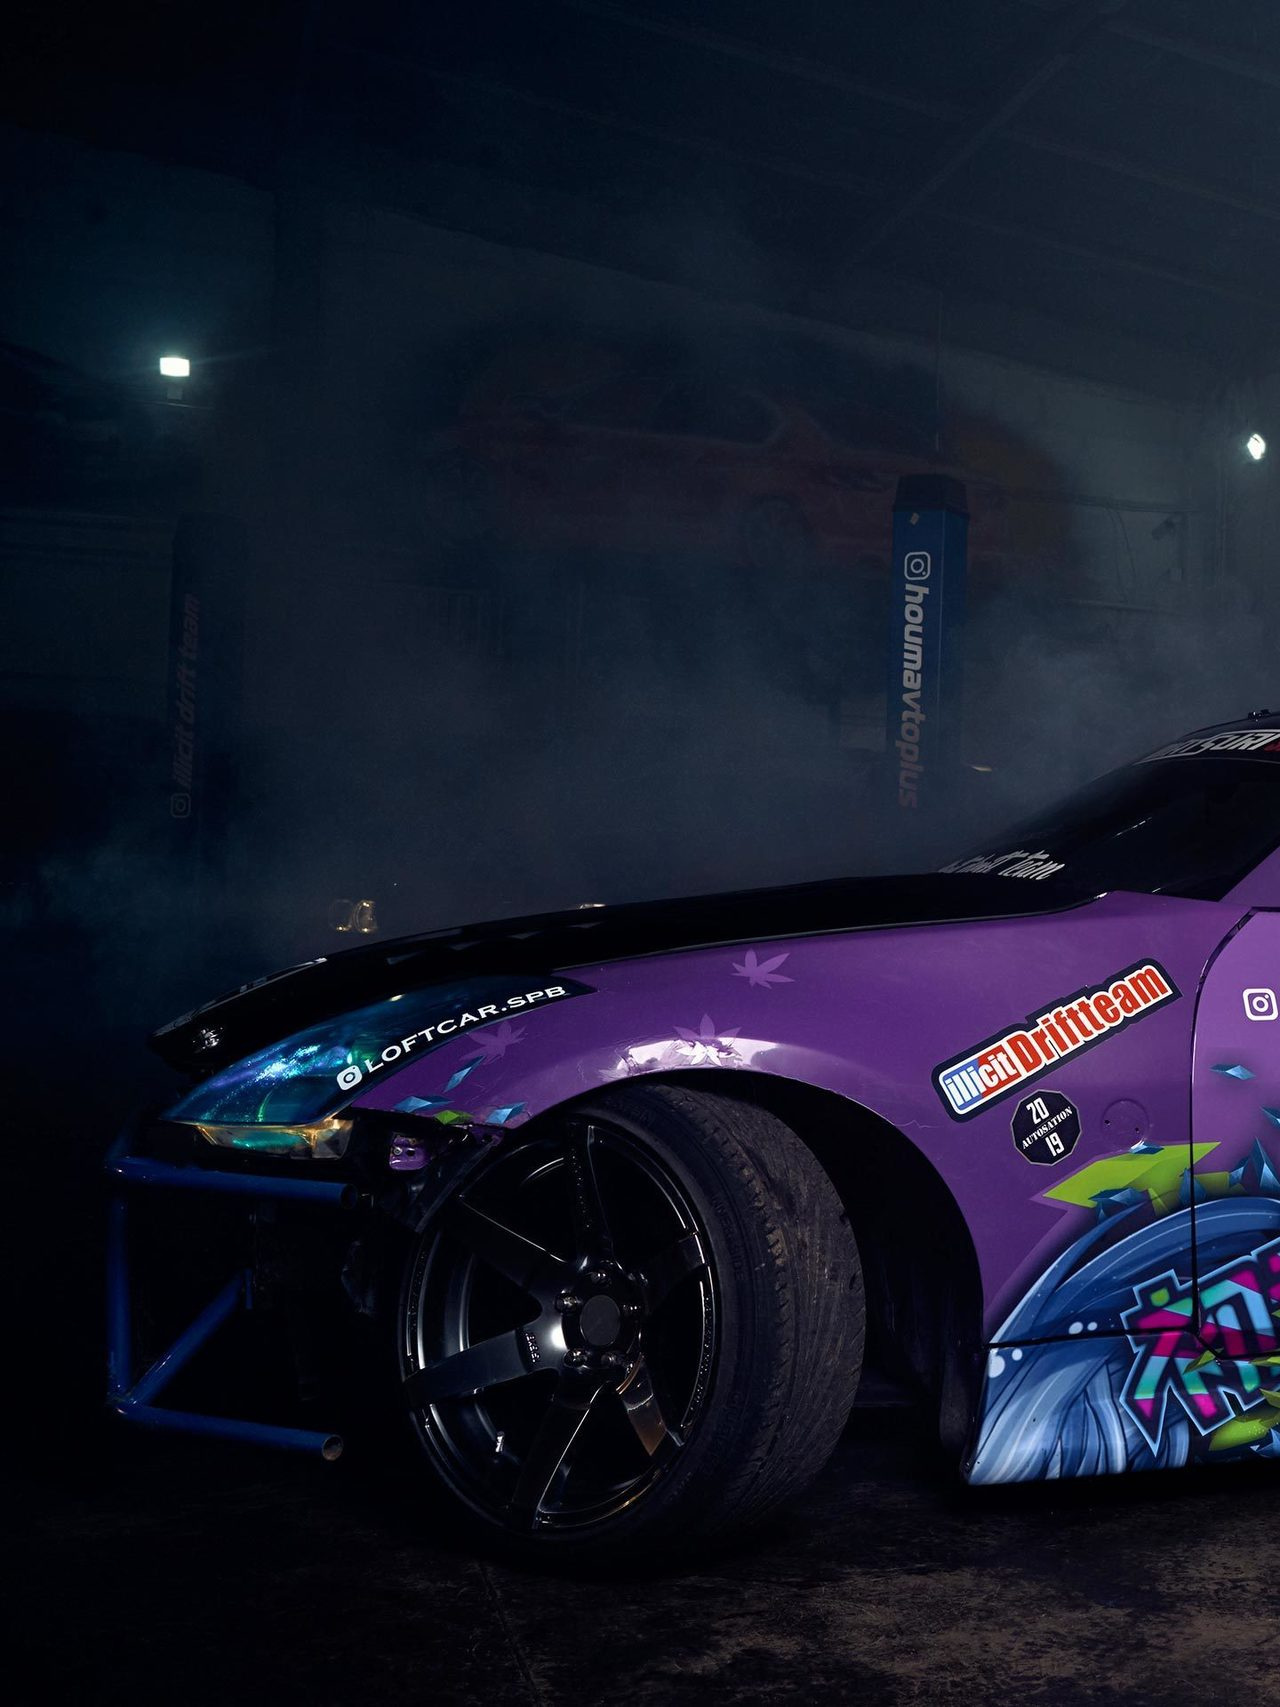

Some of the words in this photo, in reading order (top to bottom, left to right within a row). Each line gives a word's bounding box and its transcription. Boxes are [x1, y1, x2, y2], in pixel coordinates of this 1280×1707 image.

[896, 583, 930, 808] houmavtoplus
[364, 986, 567, 1073] LOFTCAR.SPB
[1021, 1106, 1073, 1150] AUTOSATION
[1025, 1097, 1050, 1125] 20
[1044, 1131, 1065, 1157] 19
